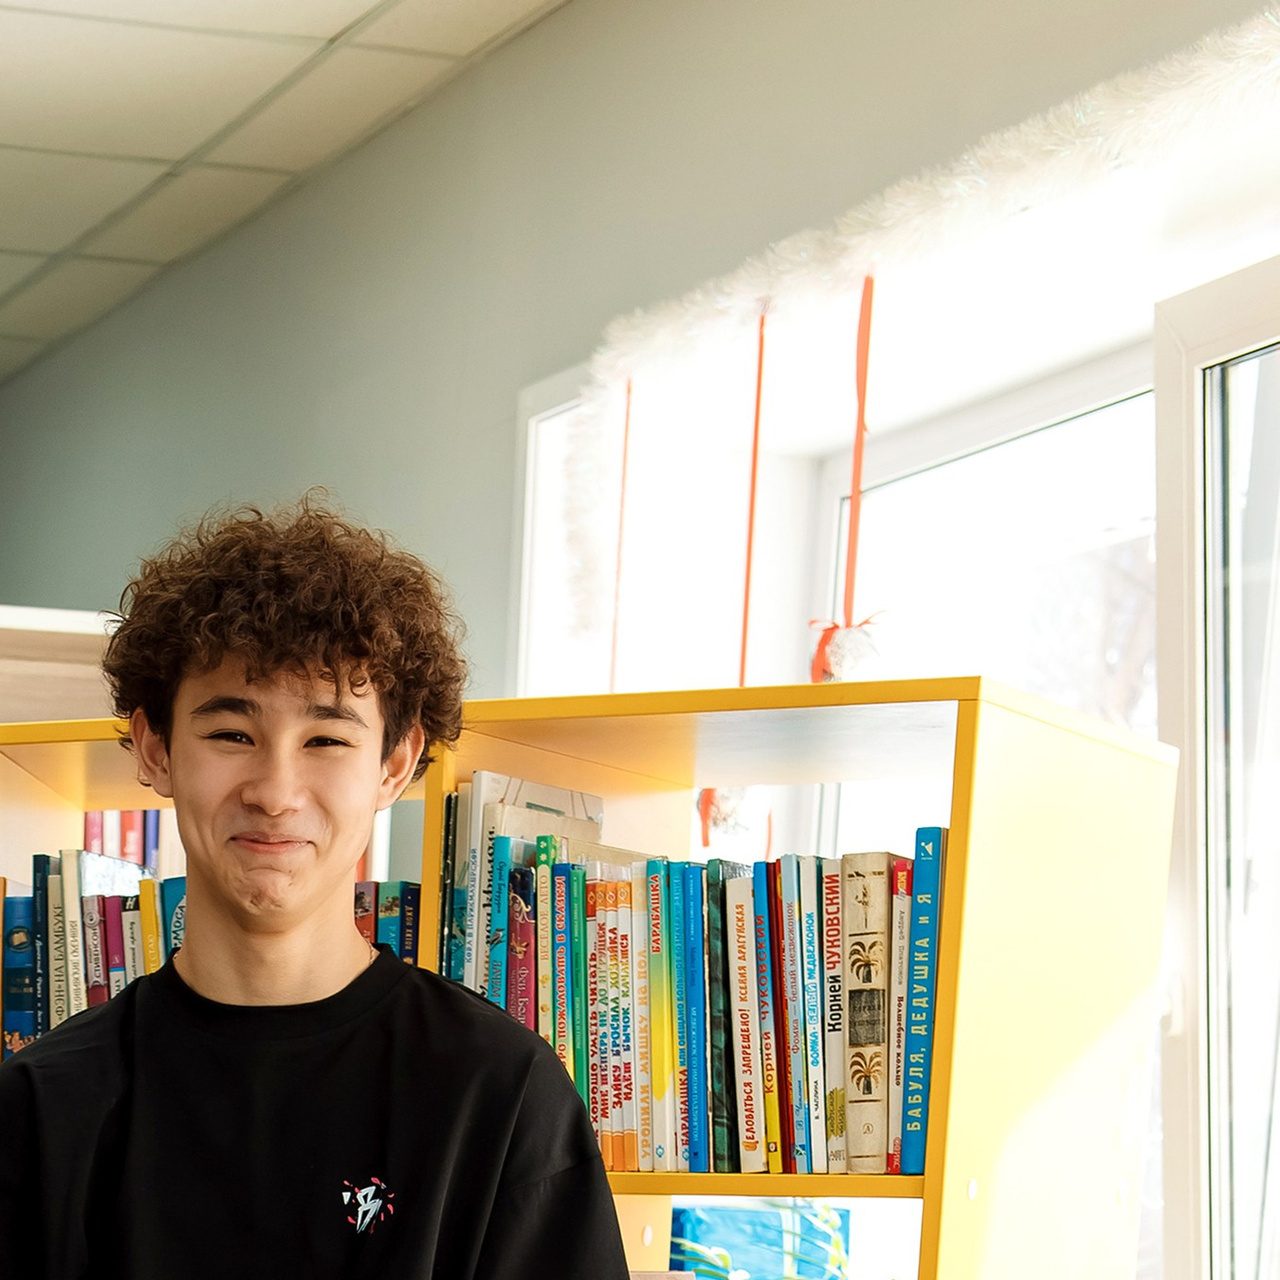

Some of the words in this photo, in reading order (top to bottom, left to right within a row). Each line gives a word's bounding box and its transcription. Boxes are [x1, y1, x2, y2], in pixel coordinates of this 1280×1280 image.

[555, 876, 566, 929] СКАЗКУ!
[649, 874, 661, 953] БАРАБАШКА
[823, 873, 840, 970] ЧУКОВСКИЙ
[917, 893, 931, 904] Я
[90, 928, 102, 978] СТИВЕНСОН
[735, 903, 747, 961] ДРАГУНСКАЯ
[785, 901, 796, 965] медвежонок
[555, 947, 567, 1038] ПОЖАЛОВАТЬ
[737, 965, 749, 1002] КСЕНИЯ
[755, 914, 769, 1020] ЧУКОВСКИЙ
[787, 969, 798, 1002] белый
[908, 937, 930, 1035] ДЕДУШКА
[827, 974, 843, 1032] Корней
[895, 996, 904, 1049] Волшебное
[739, 1008, 753, 1076] ЗАПРЕЩЕНО!
[761, 1030, 774, 1094] Корней
[789, 1019, 800, 1054] Фомка
[894, 1052, 902, 1086] кольцо
[906, 1047, 928, 1131] БАБУЛЯ,
[741, 1082, 758, 1151] ЦЕЛОВАТЬСЯ
